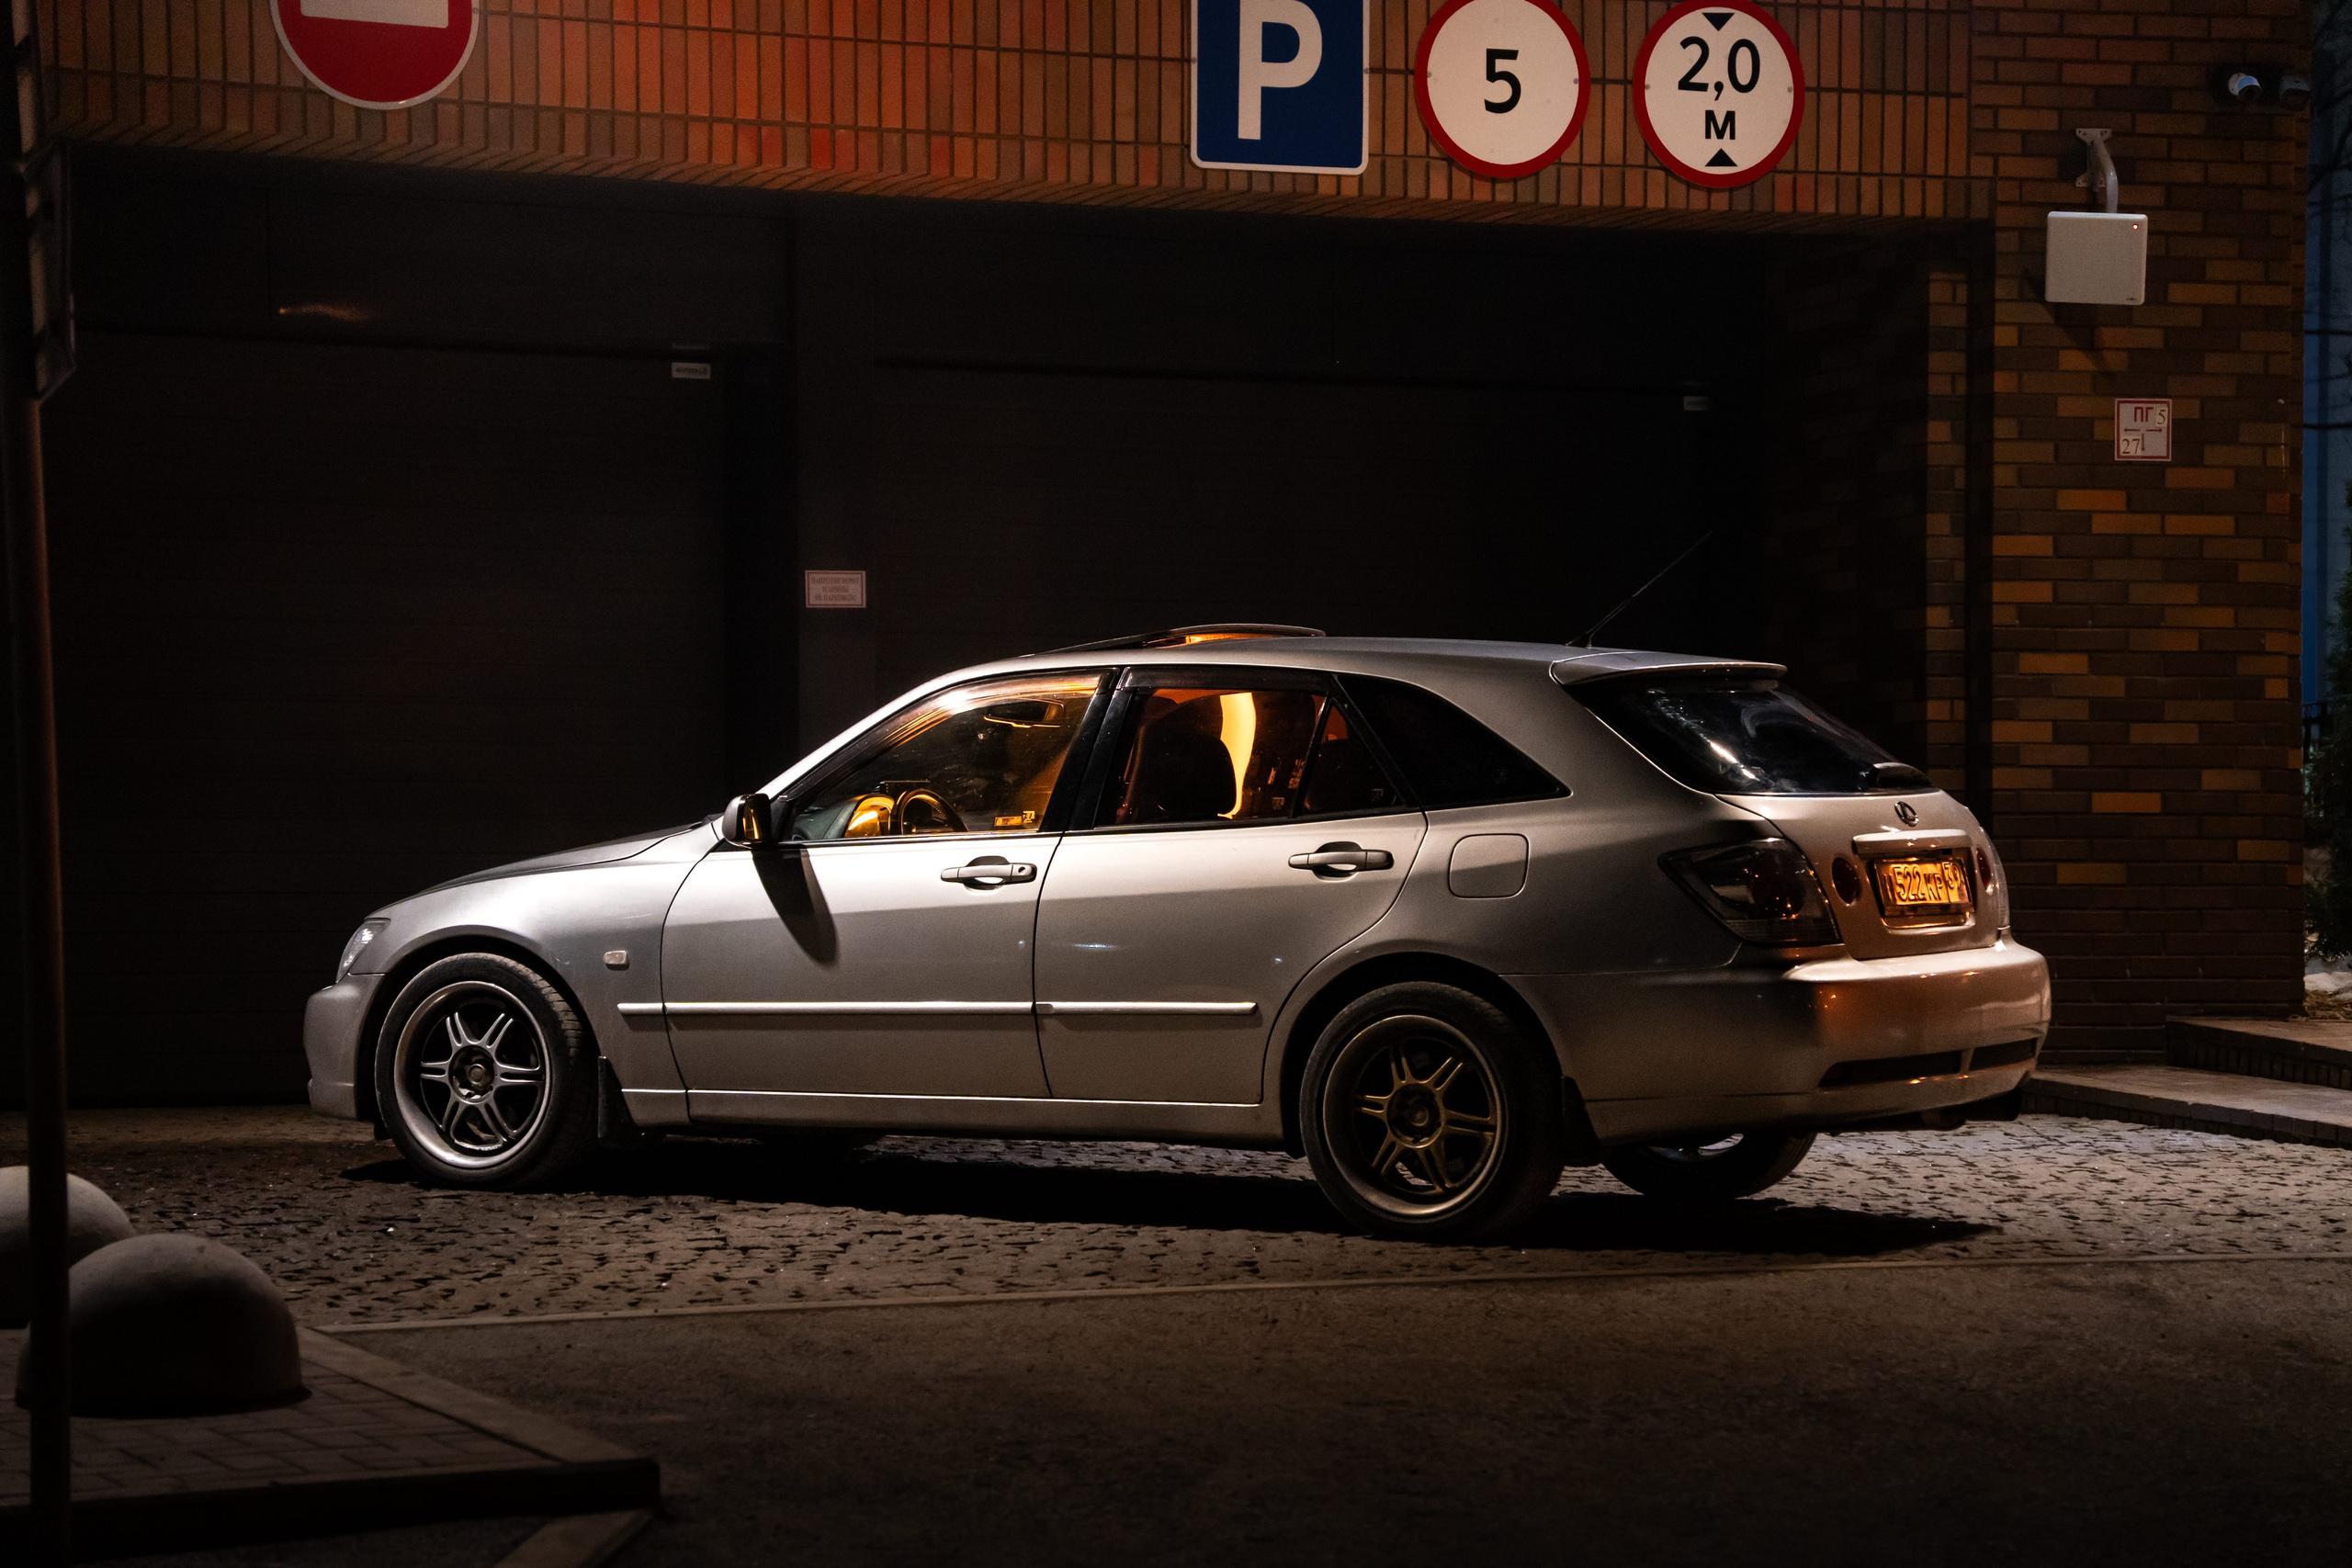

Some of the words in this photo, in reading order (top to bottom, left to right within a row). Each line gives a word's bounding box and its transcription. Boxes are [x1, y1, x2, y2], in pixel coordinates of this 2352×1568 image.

[1238, 0, 1323, 141] P
[1483, 48, 1522, 115] 5
[1677, 36, 1762, 102] 2,0
[1704, 110, 1737, 141] М
[2133, 406, 2154, 423] ПГ
[2156, 409, 2166, 425] 5
[2121, 438, 2141, 455] 27
